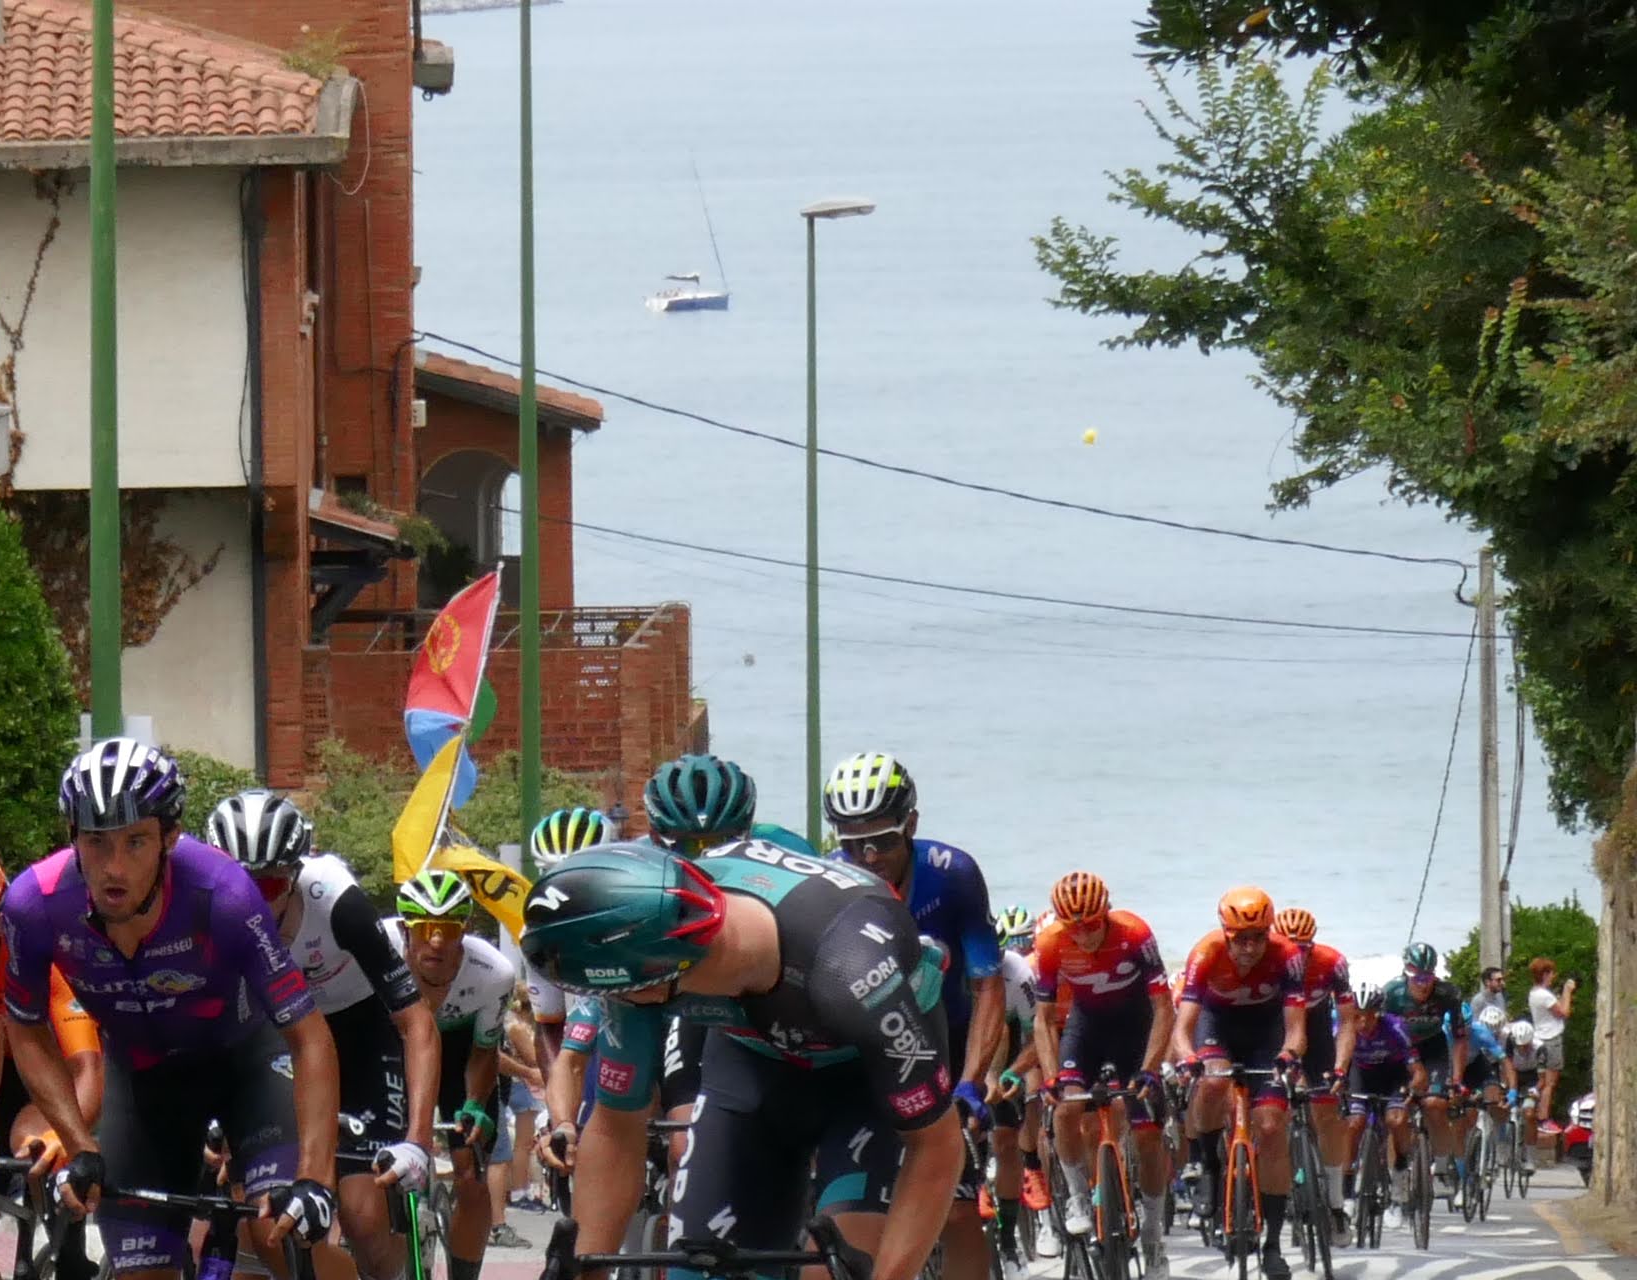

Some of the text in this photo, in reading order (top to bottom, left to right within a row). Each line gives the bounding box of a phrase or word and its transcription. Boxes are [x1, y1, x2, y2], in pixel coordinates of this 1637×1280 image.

[585, 968, 629, 977] BORA
[850, 956, 899, 1000] BORA
[386, 1071, 404, 1130] UAE
[245, 1162, 278, 1182] BH
[122, 1235, 157, 1251] BH
